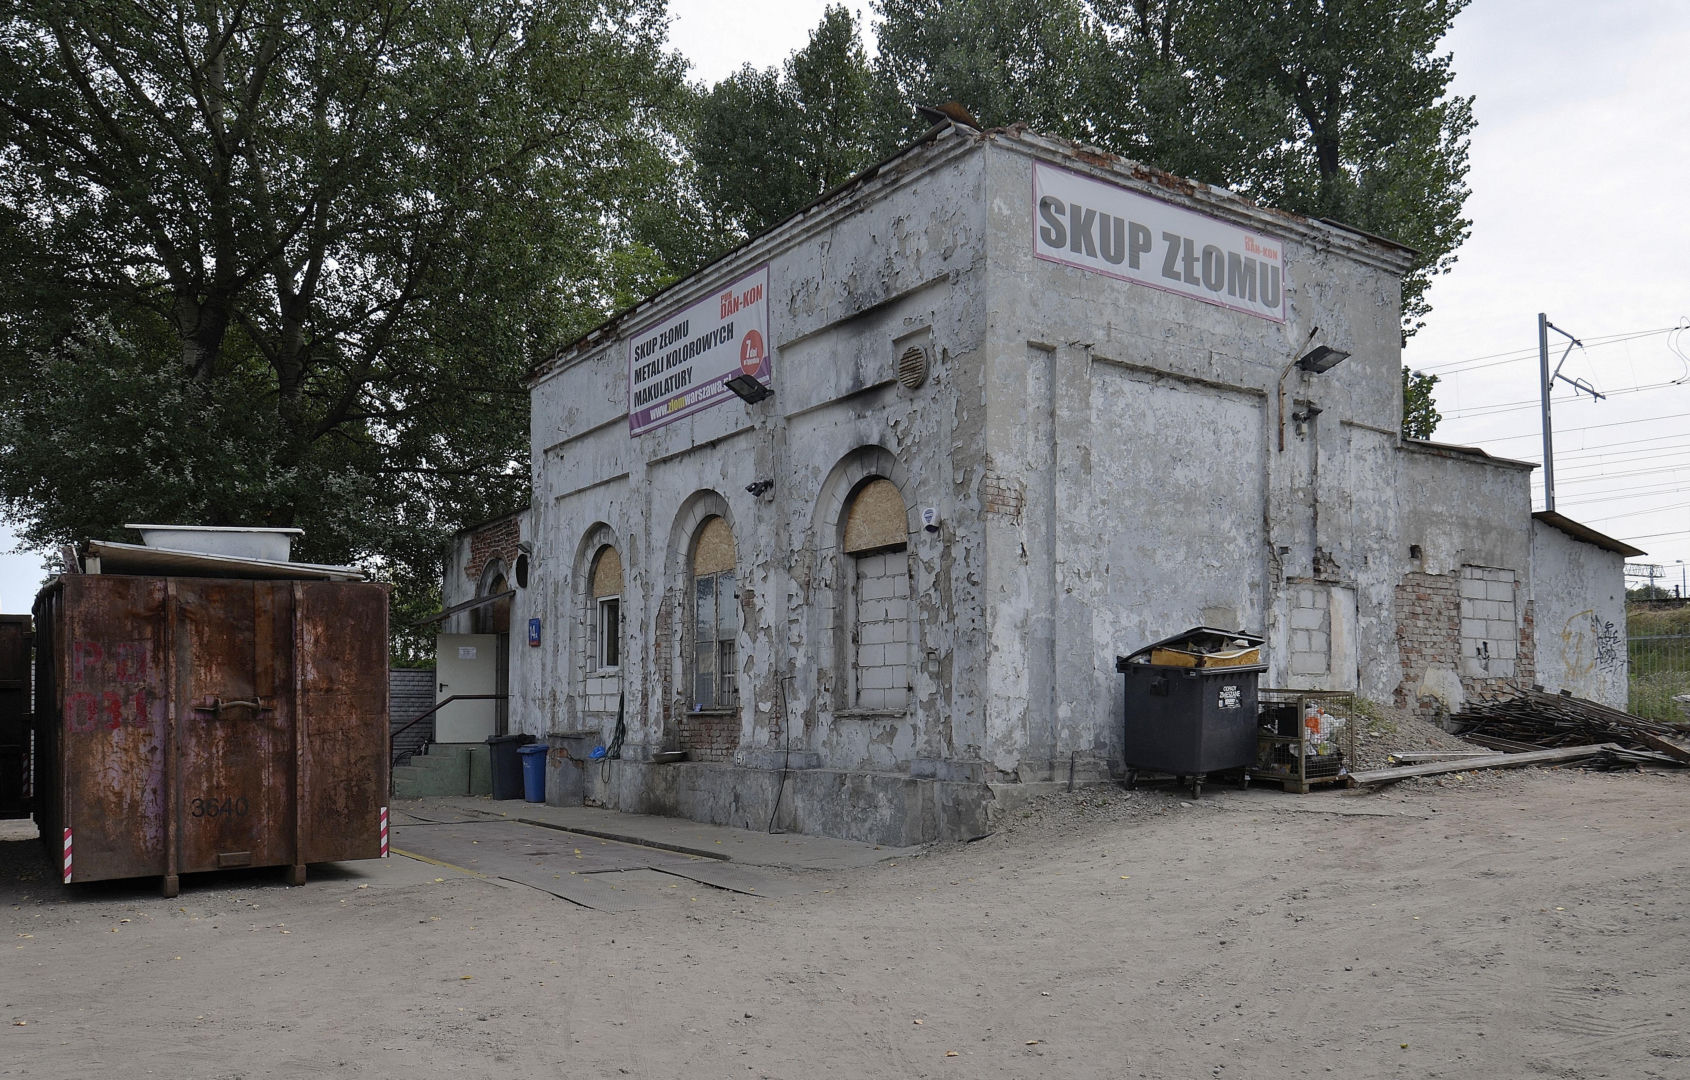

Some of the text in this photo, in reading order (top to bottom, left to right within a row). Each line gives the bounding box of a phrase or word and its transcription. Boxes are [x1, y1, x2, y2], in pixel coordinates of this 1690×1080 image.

[1039, 195, 1281, 309] SKUP ZŁOMU
[720, 284, 763, 320] DAN-KON
[634, 320, 689, 362] SKUP ZŁOMU
[634, 322, 734, 385] METALI KOLOROWYCH
[634, 367, 693, 408] MAKULATURY
[191, 797, 249, 817] 3640
